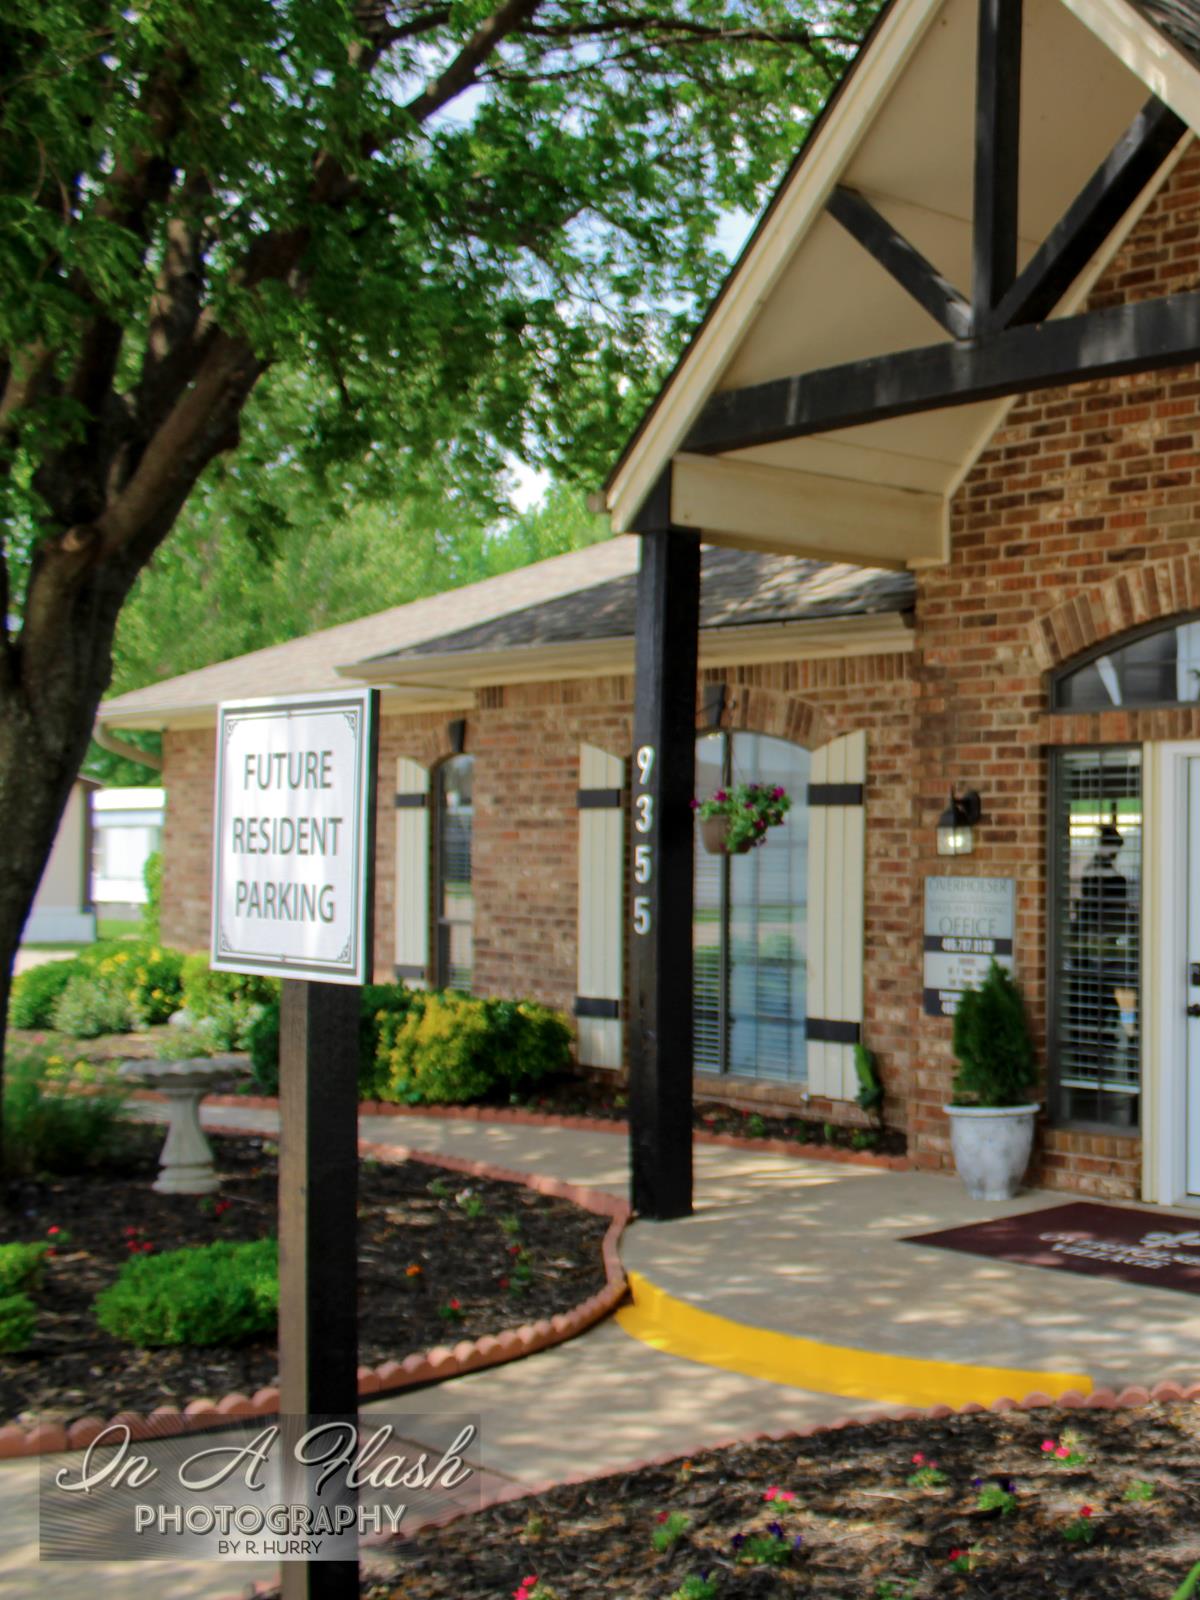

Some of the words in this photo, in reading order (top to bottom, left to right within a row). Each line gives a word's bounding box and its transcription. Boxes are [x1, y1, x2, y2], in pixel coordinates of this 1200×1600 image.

[243, 750, 333, 790] FUTURE
[232, 817, 343, 856] RESIDENT
[634, 746, 655, 935] 9355
[235, 880, 336, 924] PARKING
[939, 916, 997, 937] OFFICE
